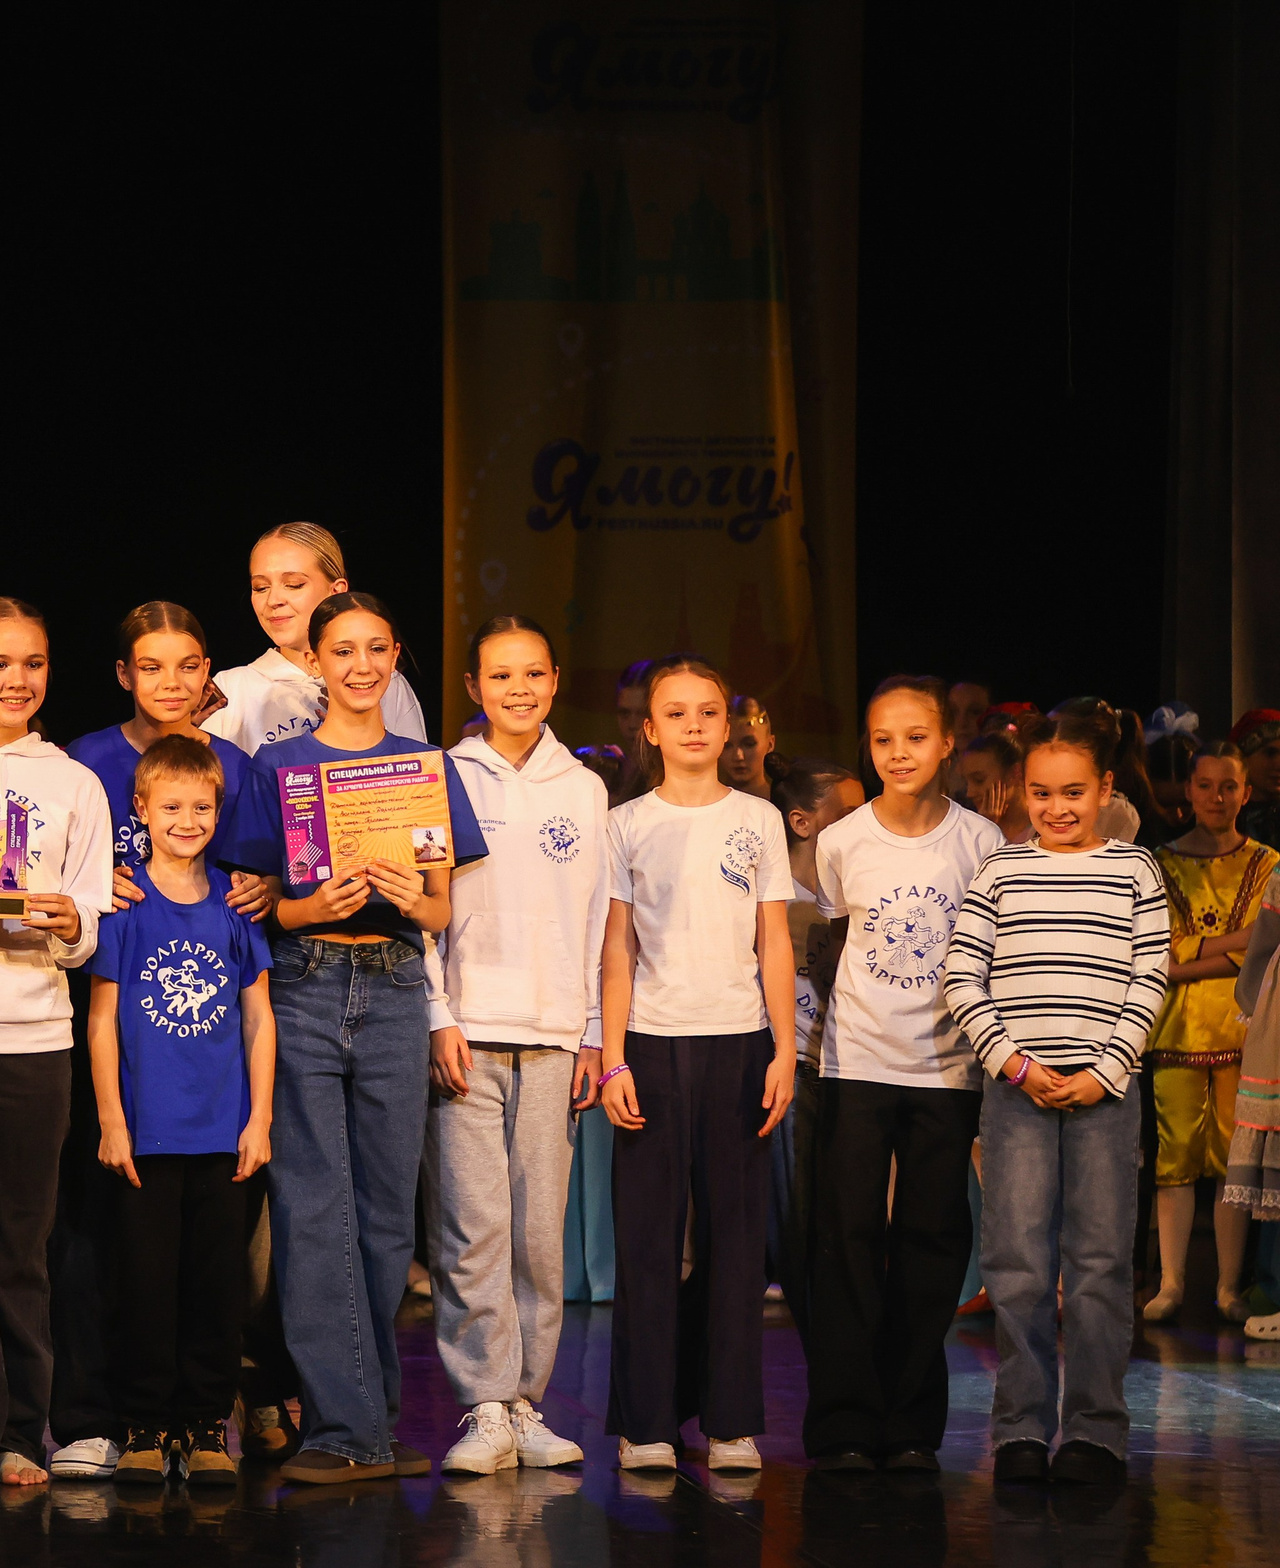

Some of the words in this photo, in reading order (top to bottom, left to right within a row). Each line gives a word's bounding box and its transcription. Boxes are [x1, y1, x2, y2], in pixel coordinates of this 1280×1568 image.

[525, 437, 601, 531] Я
[595, 450, 794, 542] могу!
[329, 764, 394, 781] СПЕЦИАЛЬНЫЙ
[395, 762, 419, 773] ПРИЗ
[140, 938, 229, 988] ВОЛГАРЯТА
